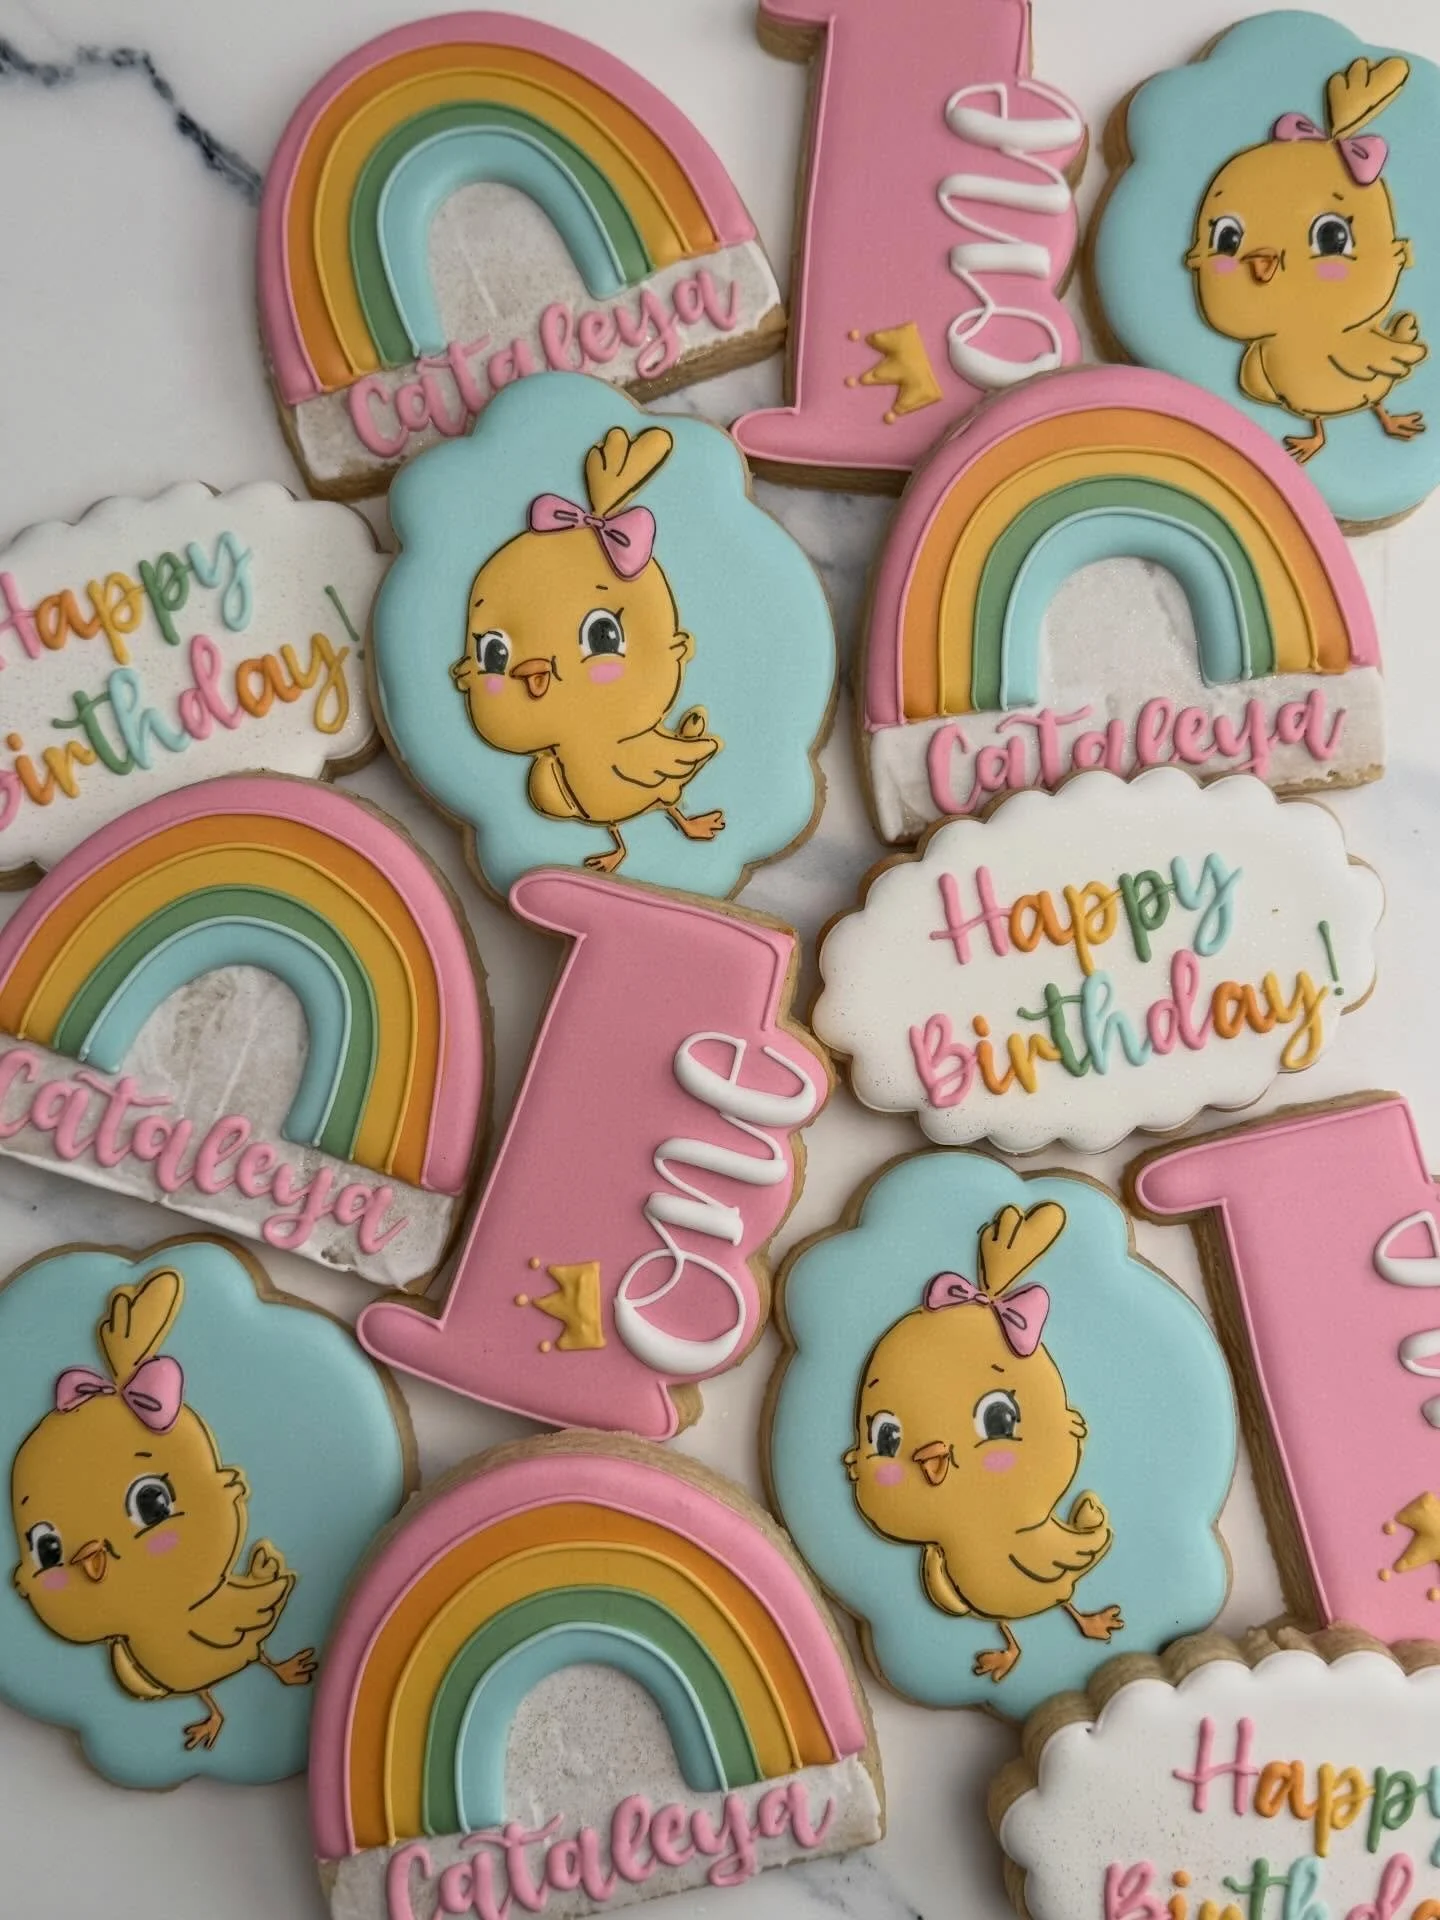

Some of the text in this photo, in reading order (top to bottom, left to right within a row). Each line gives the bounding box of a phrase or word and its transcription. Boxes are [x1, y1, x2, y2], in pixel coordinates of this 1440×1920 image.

[348, 269, 740, 458] Cataleya
[927, 688, 1347, 815] Cataleya
[929, 852, 1243, 976] Happy
[909, 918, 1345, 1109] Birthday!
[386, 1780, 836, 1920] Cataleya
[1172, 1716, 1440, 1866] Happ
